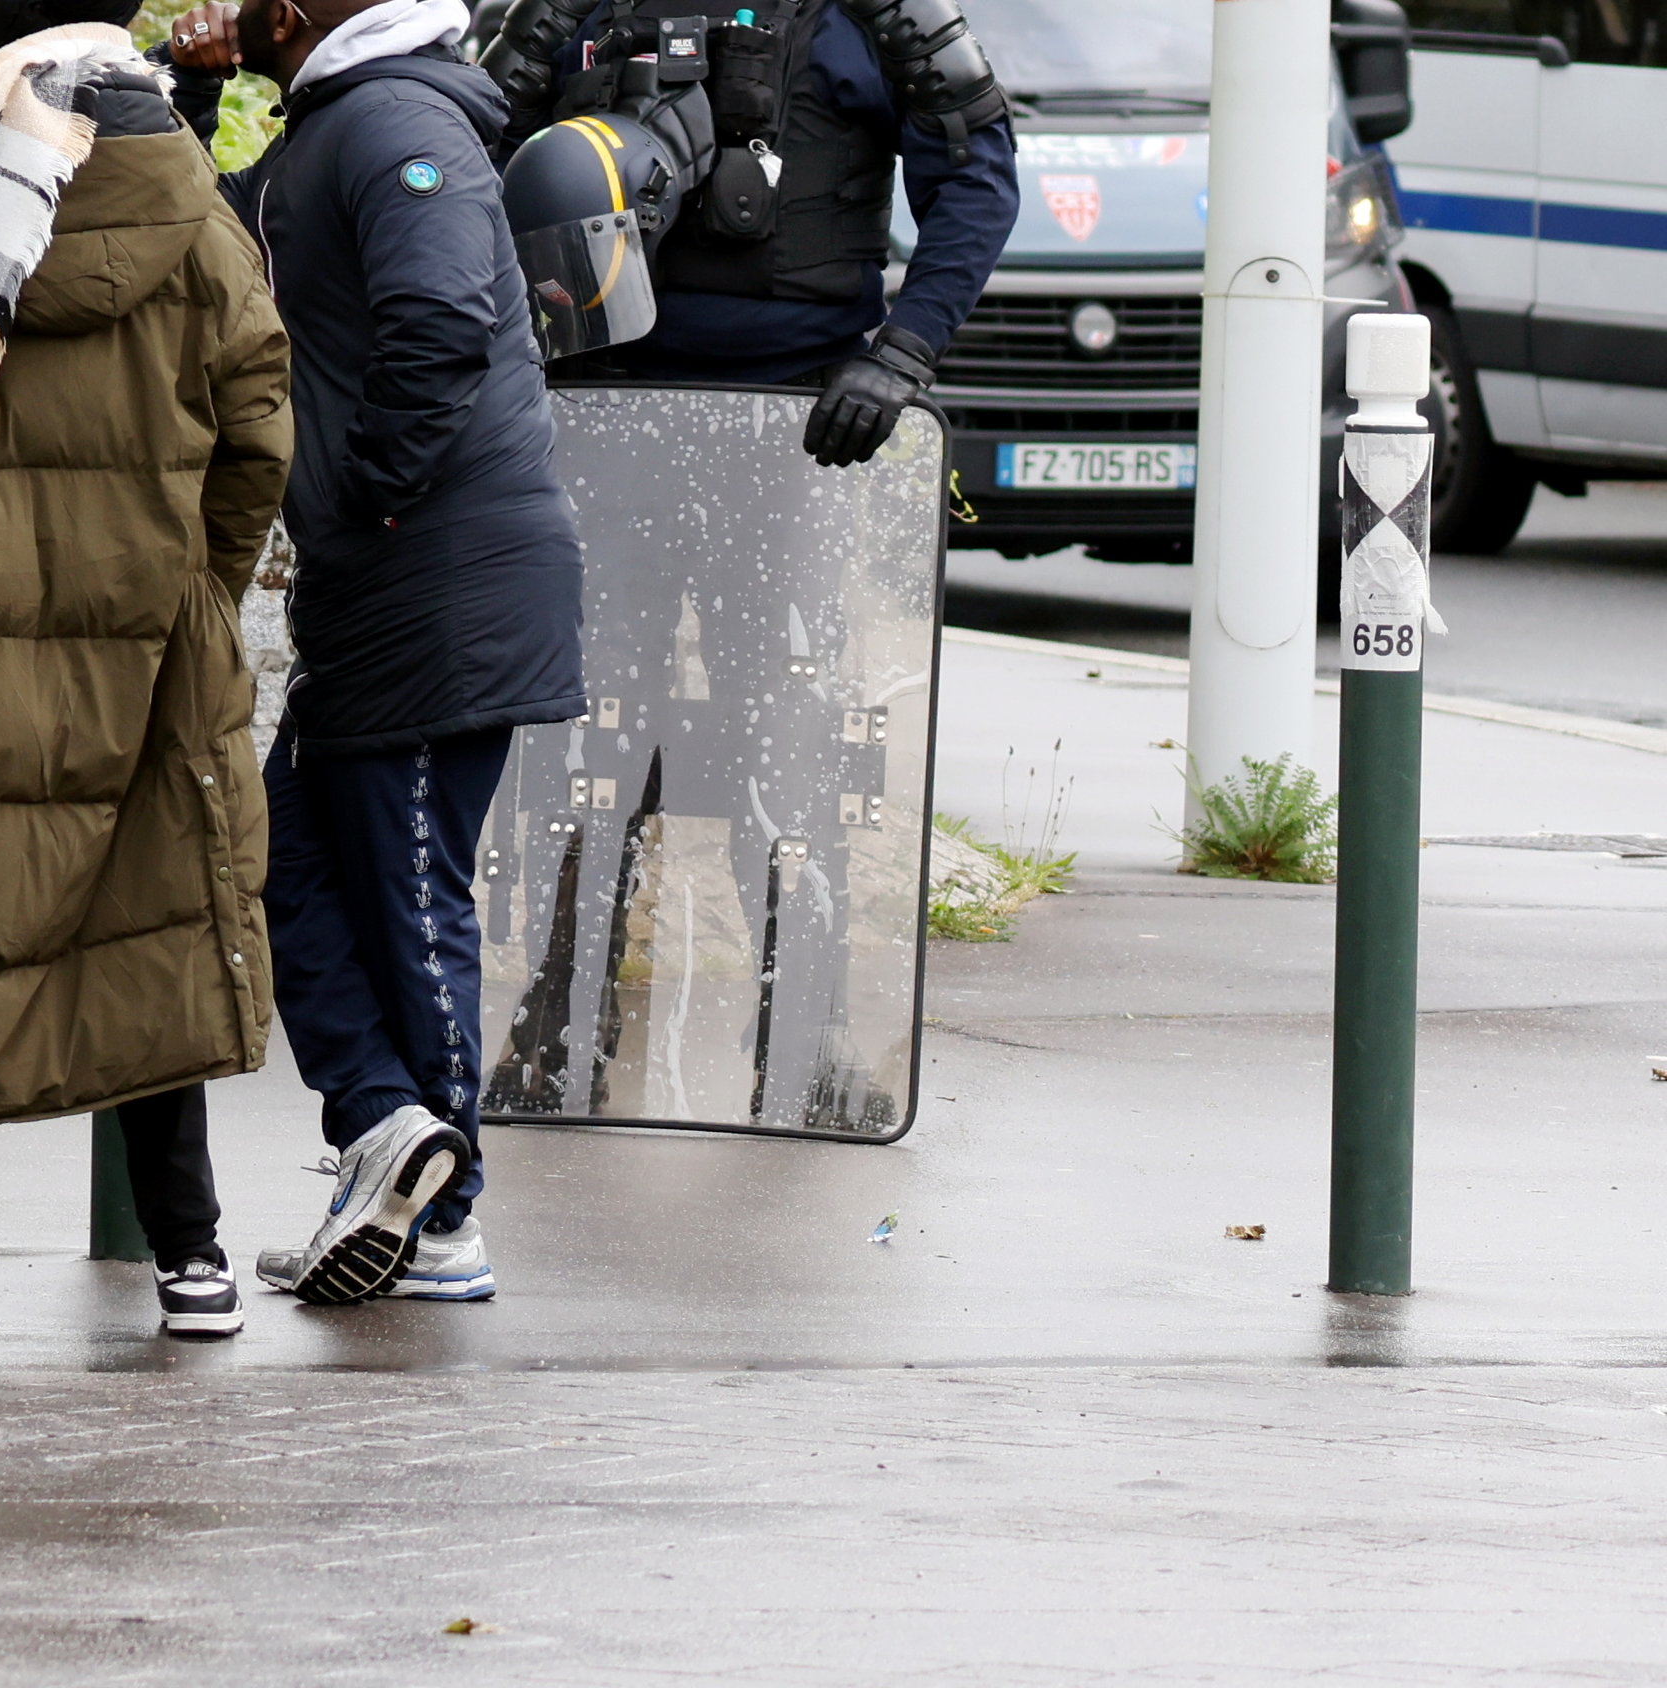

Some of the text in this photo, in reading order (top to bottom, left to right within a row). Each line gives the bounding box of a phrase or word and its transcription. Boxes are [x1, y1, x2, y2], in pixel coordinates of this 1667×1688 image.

[1021, 448, 1171, 482] FZ-705-RS
[1353, 623, 1414, 657] 658
[184, 1263, 212, 1276] NIKE
